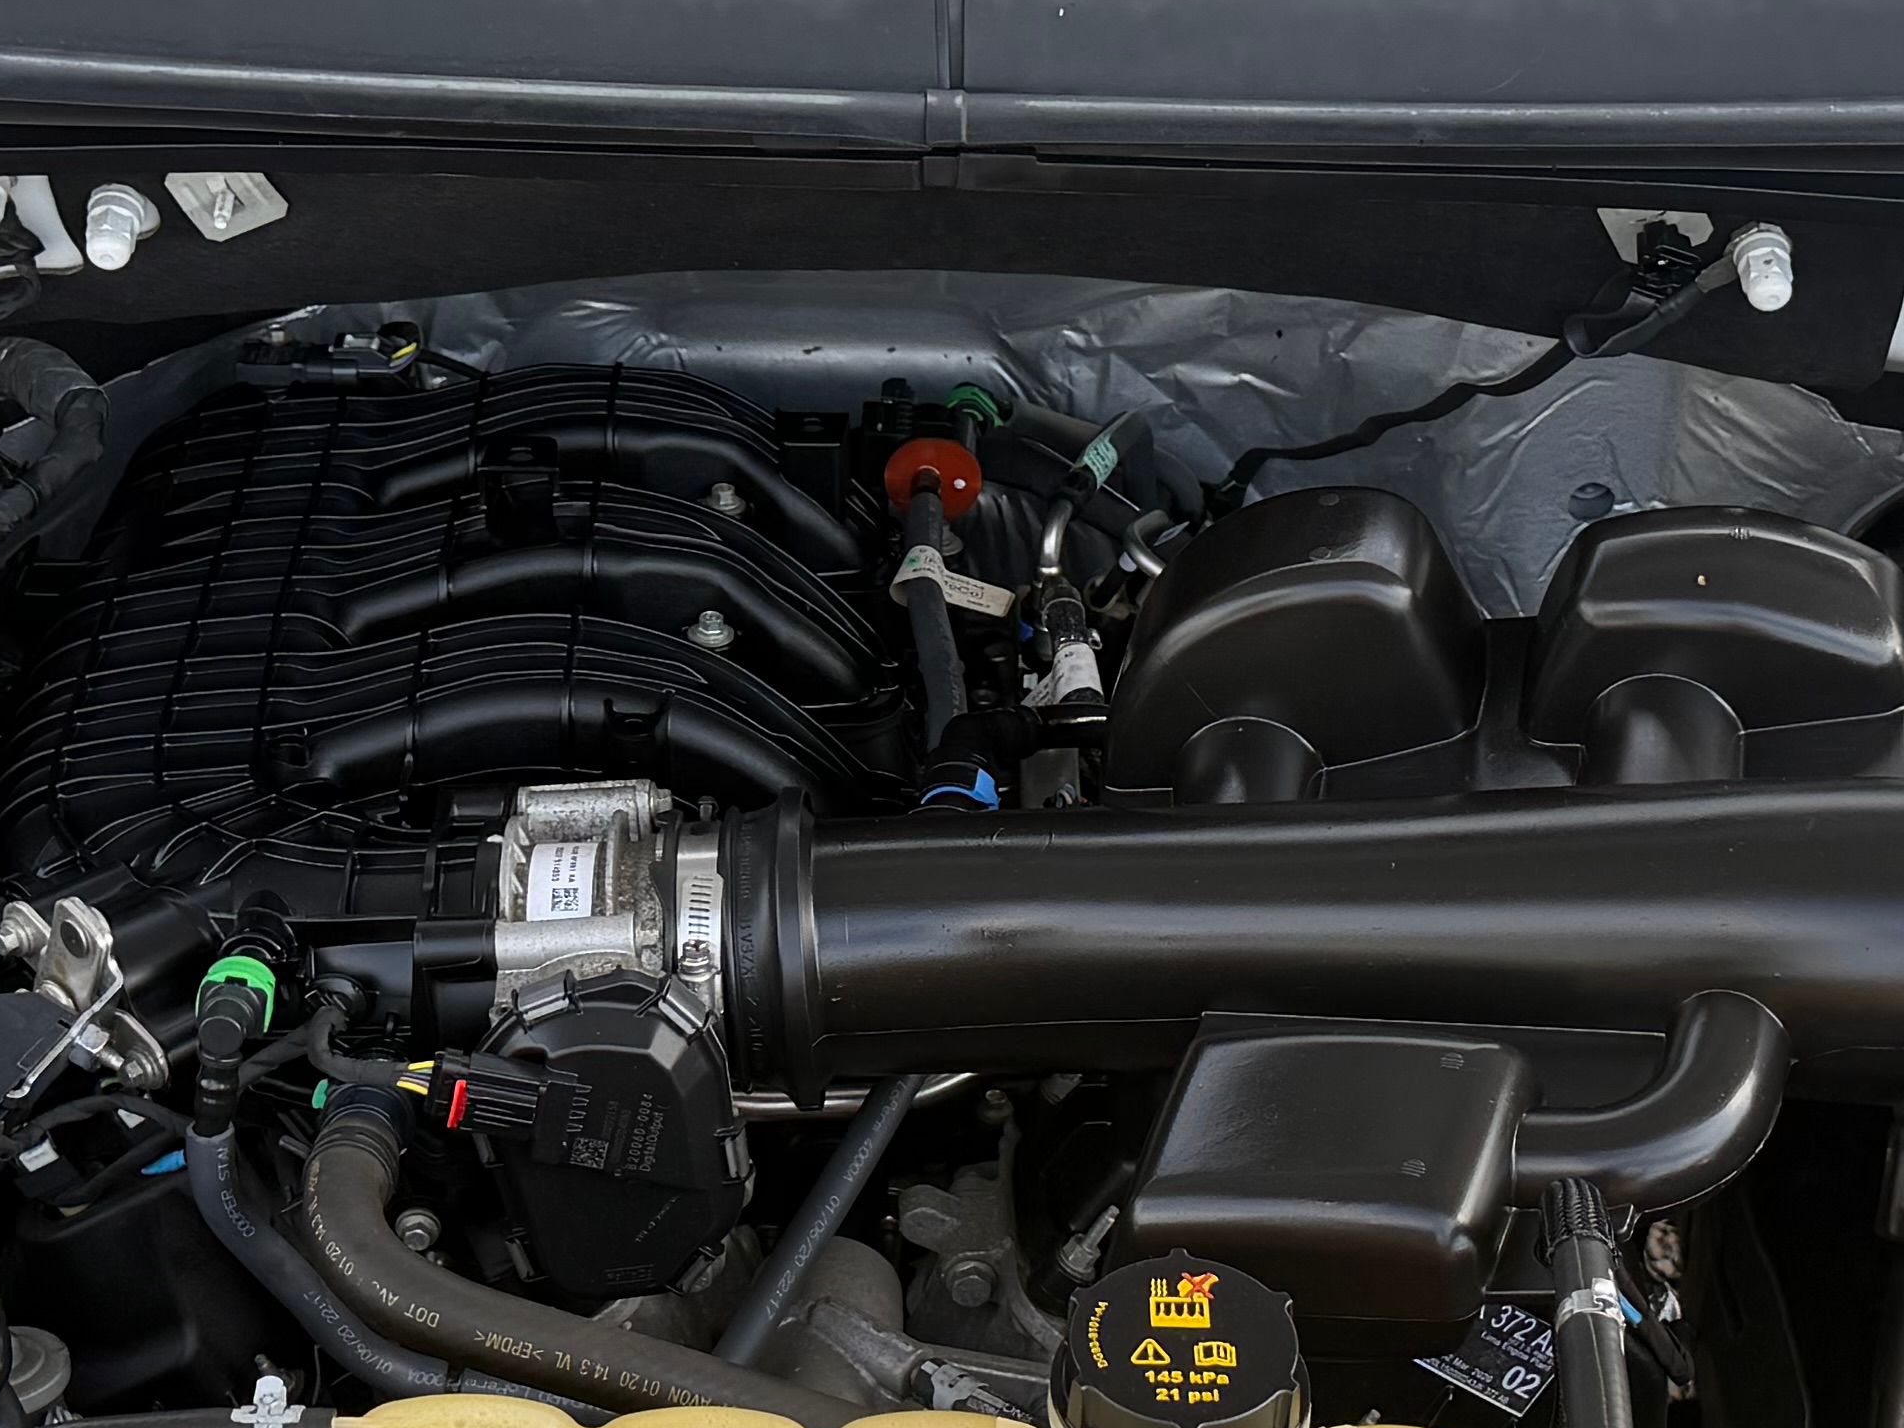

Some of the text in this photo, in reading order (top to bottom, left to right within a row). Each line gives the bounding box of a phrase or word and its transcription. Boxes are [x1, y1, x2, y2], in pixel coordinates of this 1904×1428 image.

[220, 1189, 255, 1237] COOPER
[794, 1195, 840, 1267] 01/06/20
[765, 1269, 795, 1320] 22:17
[403, 1303, 439, 1327] DOT
[474, 1330, 543, 1359] >EPDM<
[1490, 1304, 1537, 1342] 372
[1530, 1328, 1555, 1358] A
[337, 1324, 395, 1373] 01/06/20
[554, 1350, 570, 1370] VL
[579, 1358, 609, 1380] 14.3
[1144, 1370, 1231, 1386] 145 kPa
[1501, 1365, 1542, 1400] 02
[668, 1386, 711, 1413] AVON
[1155, 1387, 1220, 1404] 21 psi
